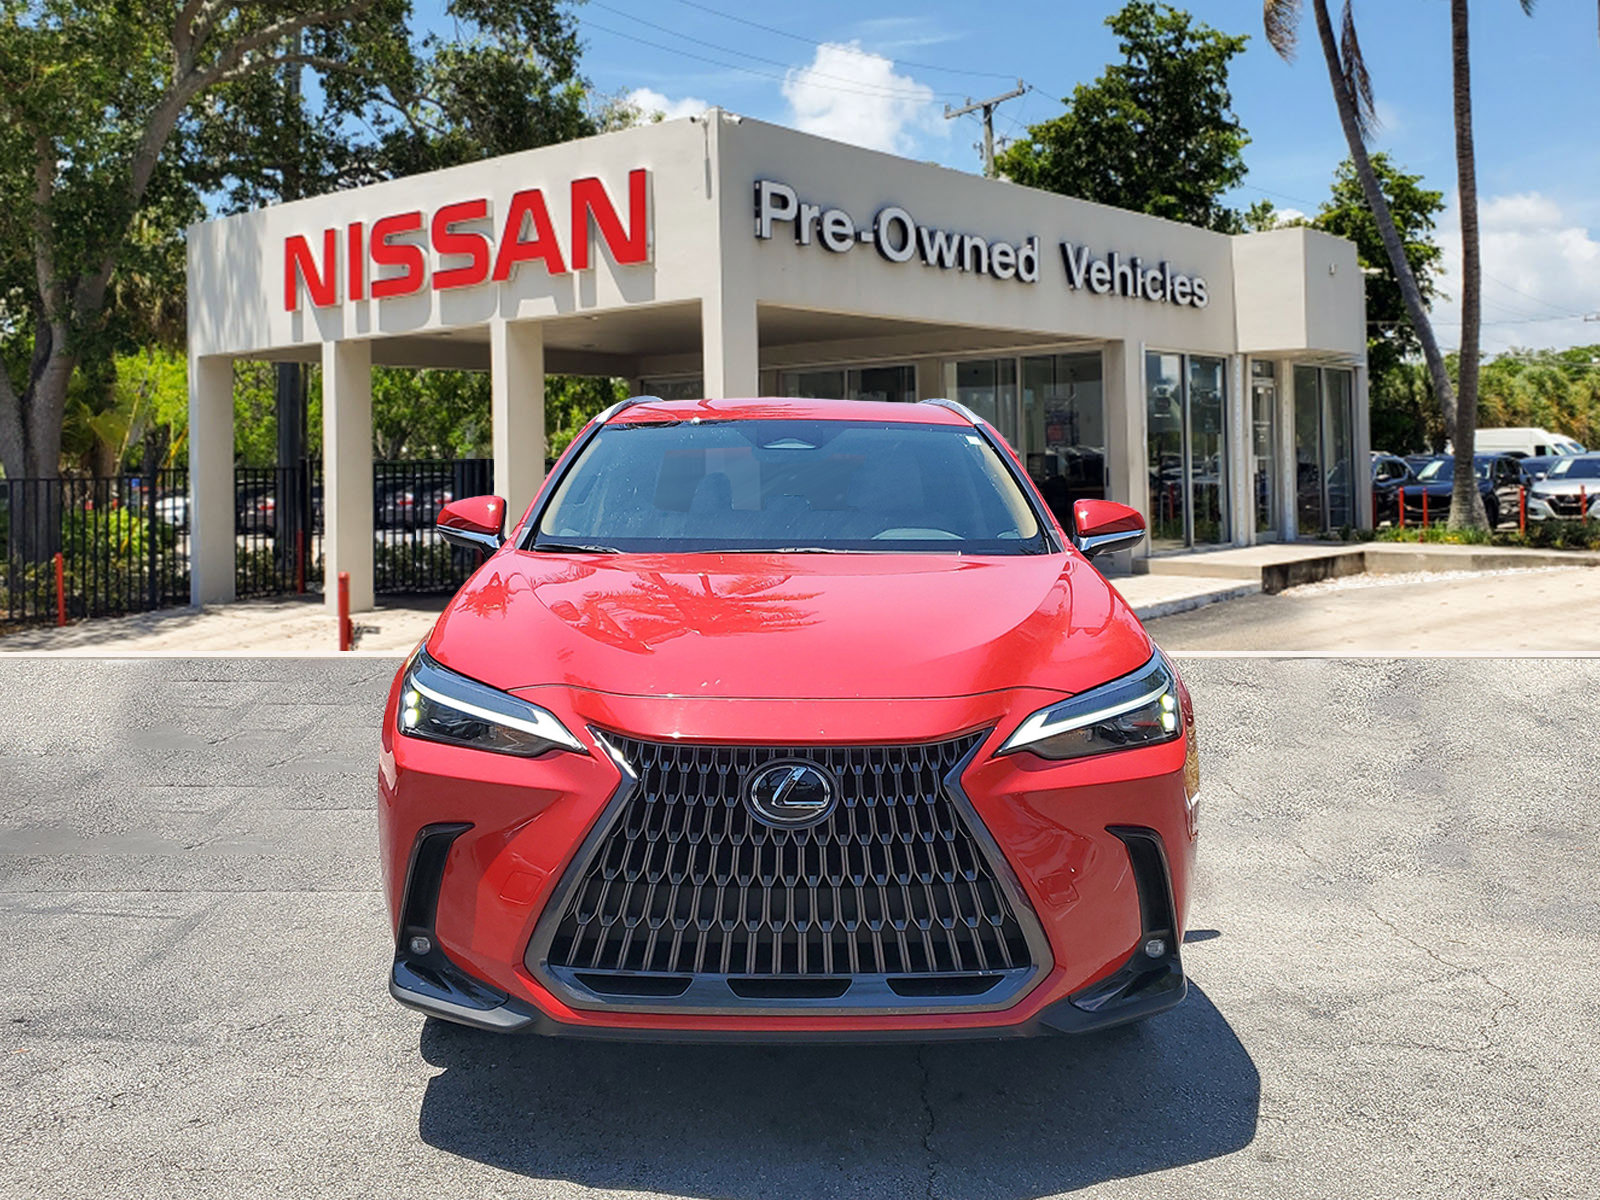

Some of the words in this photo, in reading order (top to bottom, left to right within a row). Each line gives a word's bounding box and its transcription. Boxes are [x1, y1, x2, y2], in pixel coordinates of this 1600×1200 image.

[285, 168, 649, 312] NISSAN
[754, 180, 1040, 283] Pre-Owned
[1061, 242, 1209, 308] Vehicles
